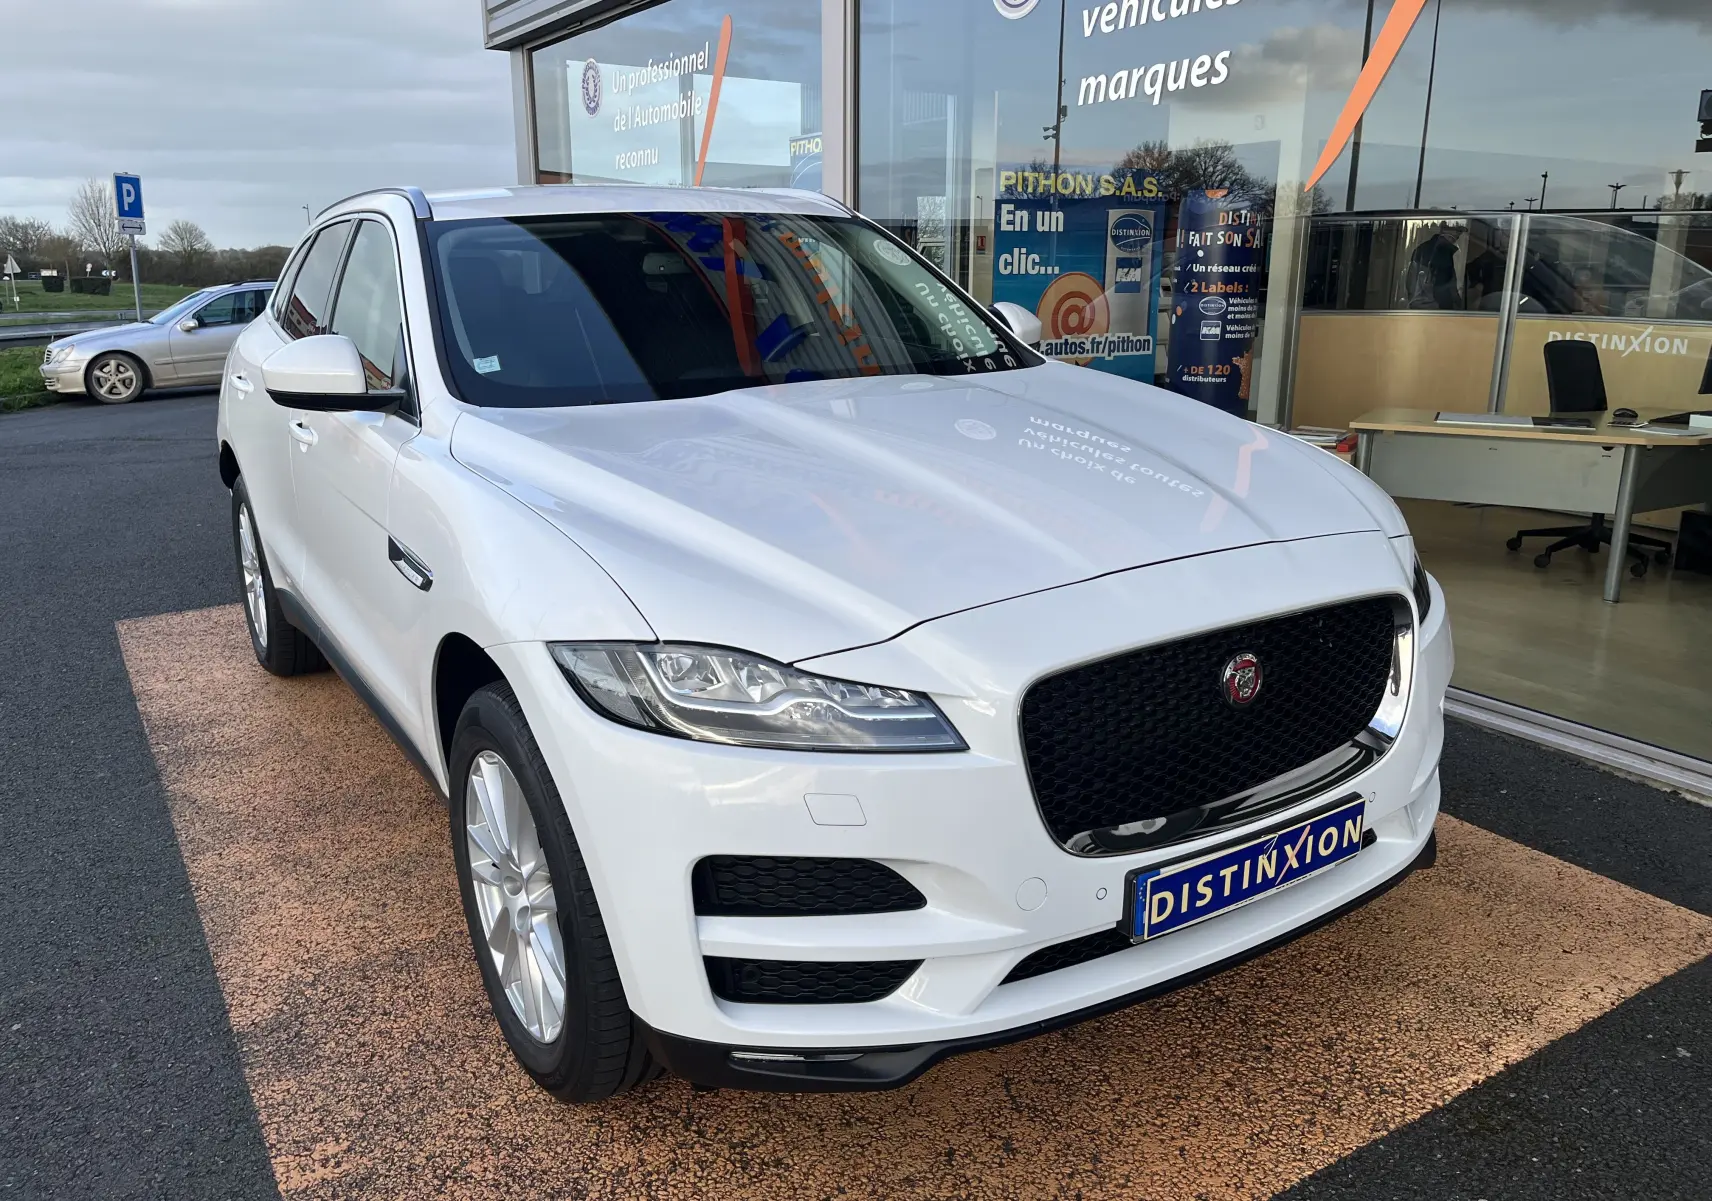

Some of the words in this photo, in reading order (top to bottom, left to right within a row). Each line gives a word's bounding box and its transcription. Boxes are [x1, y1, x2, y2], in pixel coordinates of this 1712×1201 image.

[612, 70, 626, 93] Un
[628, 41, 709, 96] professionnel
[1077, 50, 1231, 106] marques
[614, 109, 626, 132] de
[628, 90, 703, 129] l'Automobile
[615, 147, 659, 170] reconnu
[121, 182, 136, 211] P
[1000, 170, 1092, 195] PITHON
[1100, 174, 1163, 197] S.A.S.
[1000, 203, 1028, 232] En
[1036, 209, 1064, 232] un
[1111, 227, 1151, 236] DISTINXION
[1188, 231, 1213, 247] FAIT
[1217, 230, 1242, 247] SON
[998, 247, 1060, 275] clic...
[1192, 264, 1205, 272] Un
[1207, 264, 1240, 272] réseau
[1190, 282, 1198, 293] 2
[1201, 282, 1242, 293] Labels
[1182, 375, 1227, 383] distributeurs
[1190, 366, 1205, 375] DE
[1207, 365, 1230, 375] 120
[1150, 814, 1363, 925] DISTINXION
